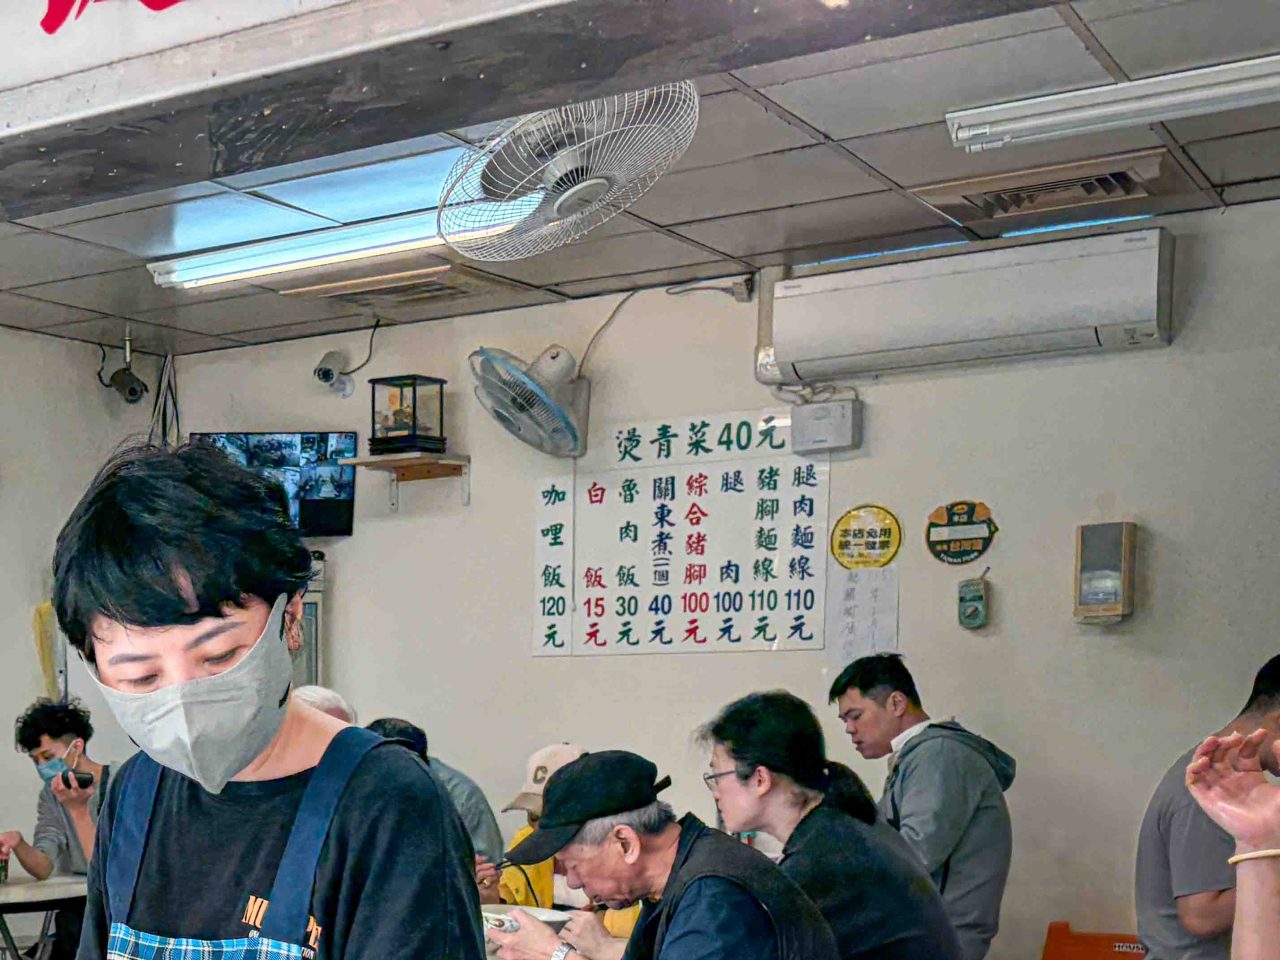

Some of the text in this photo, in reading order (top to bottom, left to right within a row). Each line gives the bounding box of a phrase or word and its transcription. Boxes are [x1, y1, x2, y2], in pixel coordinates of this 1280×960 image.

[616, 415, 786, 462] 燙青菜40元
[533, 765, 548, 784] C
